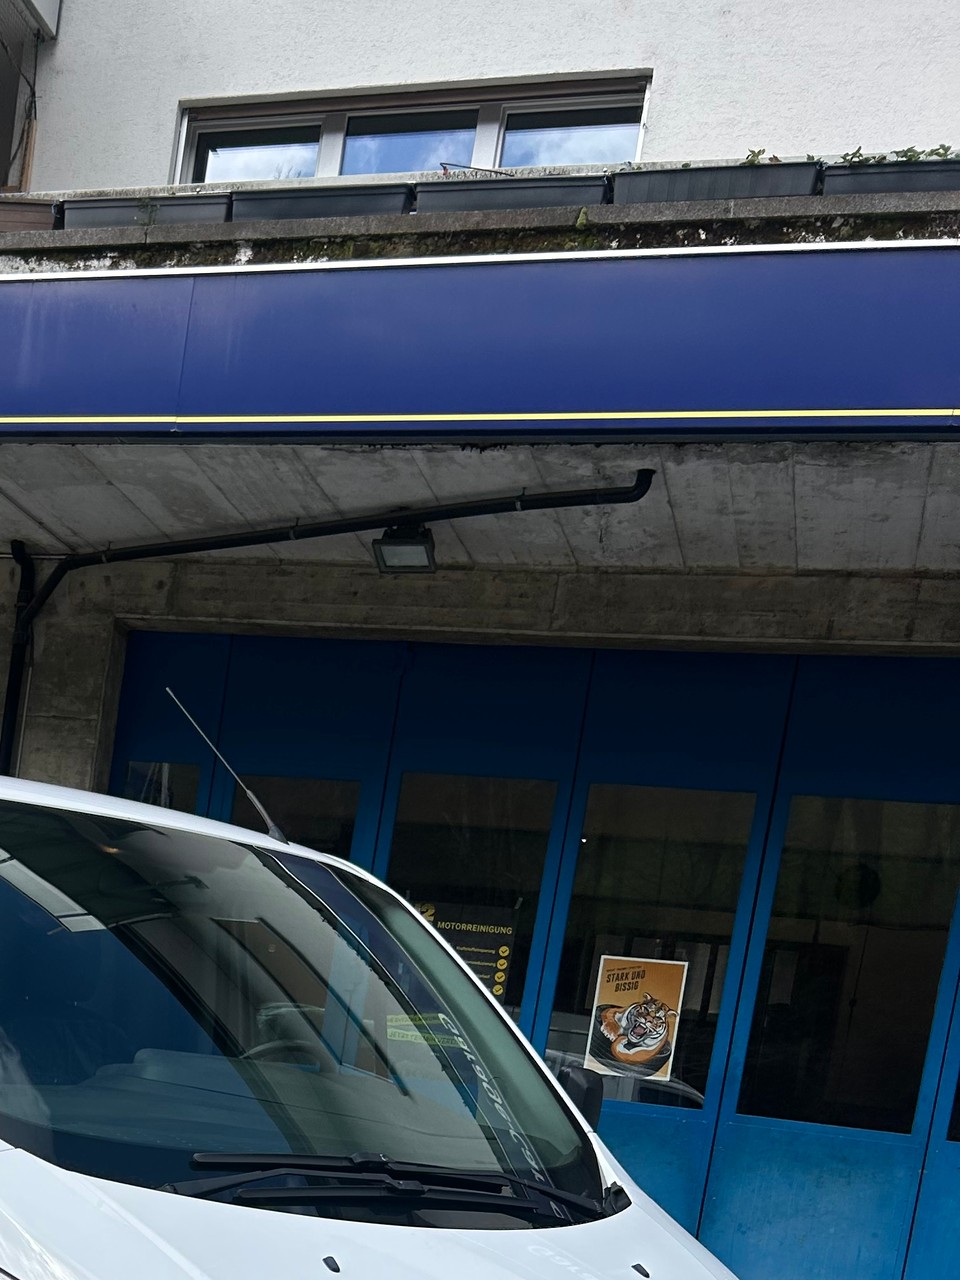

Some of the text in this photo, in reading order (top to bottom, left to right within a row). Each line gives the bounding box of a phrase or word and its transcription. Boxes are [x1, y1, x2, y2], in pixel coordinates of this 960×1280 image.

[437, 921, 513, 935] MOTORREINIGUNG
[606, 971, 630, 984] STARK
[631, 969, 646, 980] UND
[614, 980, 640, 993] BISSIG
